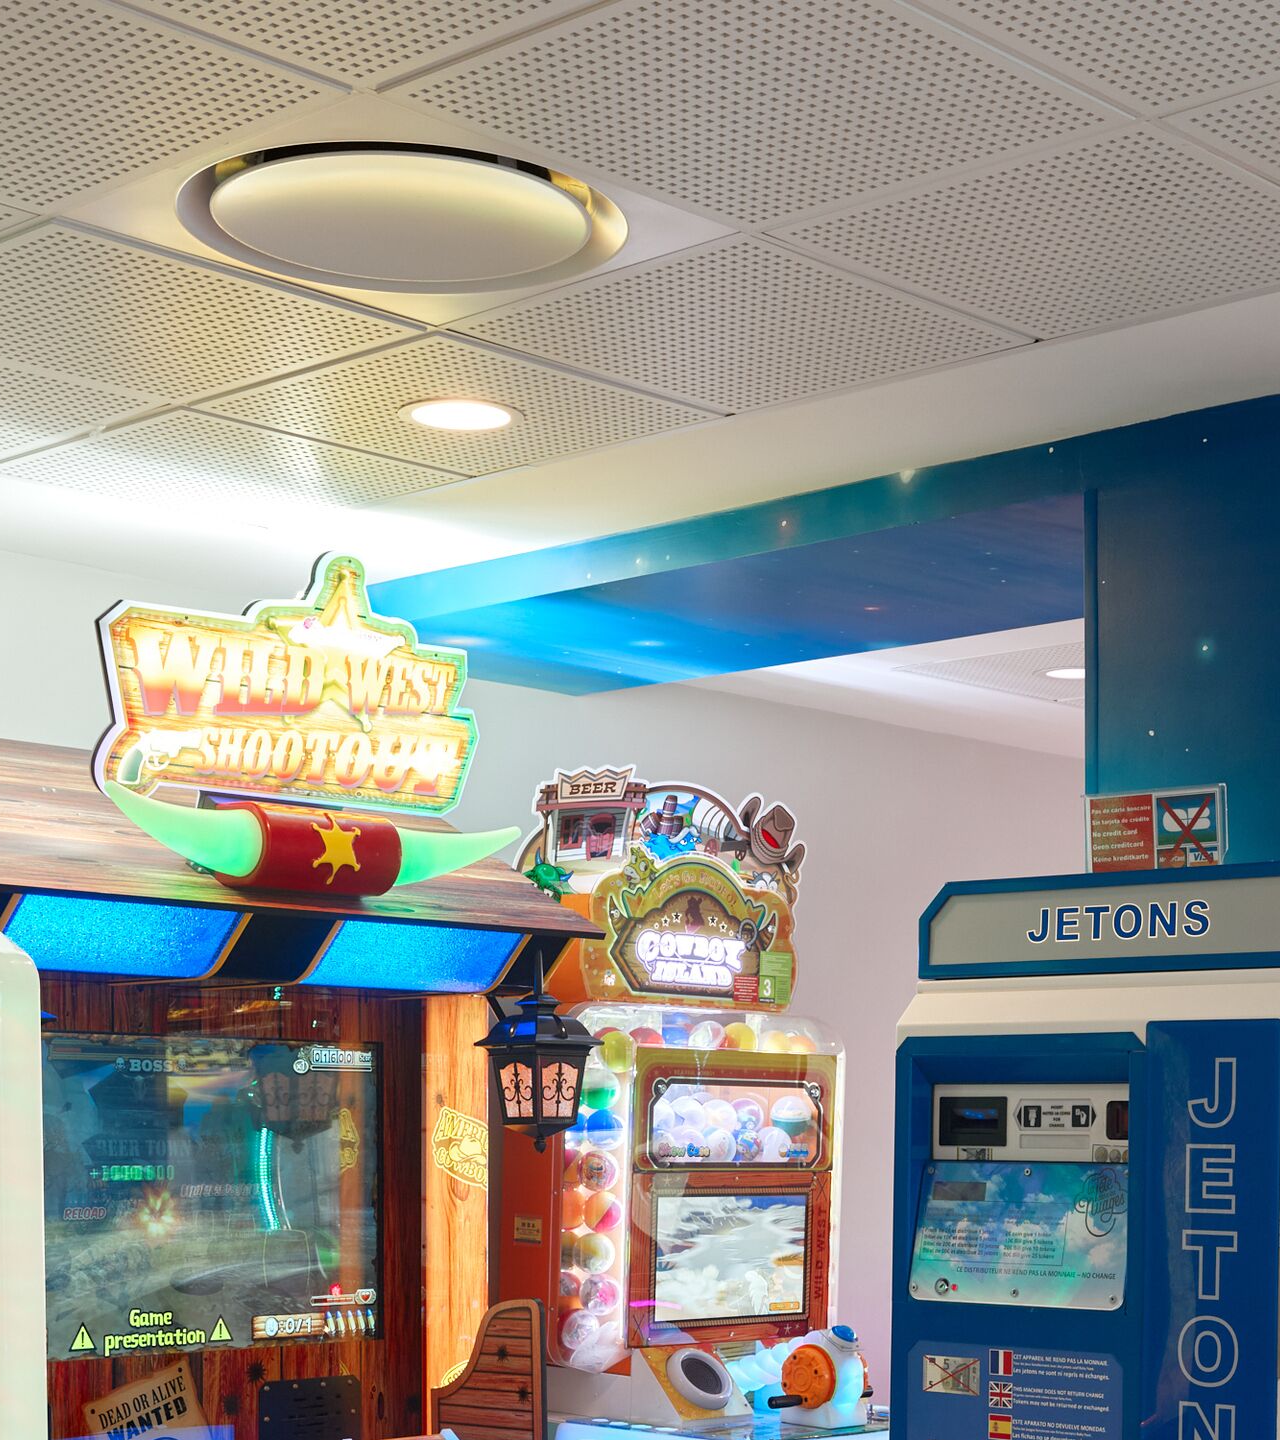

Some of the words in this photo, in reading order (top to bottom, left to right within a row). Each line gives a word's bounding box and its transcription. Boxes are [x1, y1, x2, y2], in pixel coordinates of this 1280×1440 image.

[127, 628, 325, 716] WILD
[346, 655, 457, 716] WEST
[194, 727, 463, 794] SHOOTOUT
[569, 782, 617, 795] BEER
[1111, 841, 1144, 849] creditcard
[1026, 900, 1211, 944] JETONS
[636, 930, 746, 972] COWBOY
[763, 979, 771, 996] 3
[129, 1058, 173, 1072] BOSS
[313, 1050, 353, 1063] 01600
[64, 1207, 106, 1220] RELOAD
[816, 1206, 827, 1252] WEST
[1048, 1270, 1075, 1278] MONNAIE
[1092, 1272, 1116, 1280] CHANGE
[129, 1308, 173, 1327] Game
[104, 1327, 206, 1357] presentation
[98, 1401, 131, 1430] DEAD
[132, 1393, 150, 1413] OR
[151, 1375, 186, 1405] ALIVE
[1086, 1391, 1104, 1399] CHANGE
[1056, 1423, 1080, 1431] DEVUELVE
